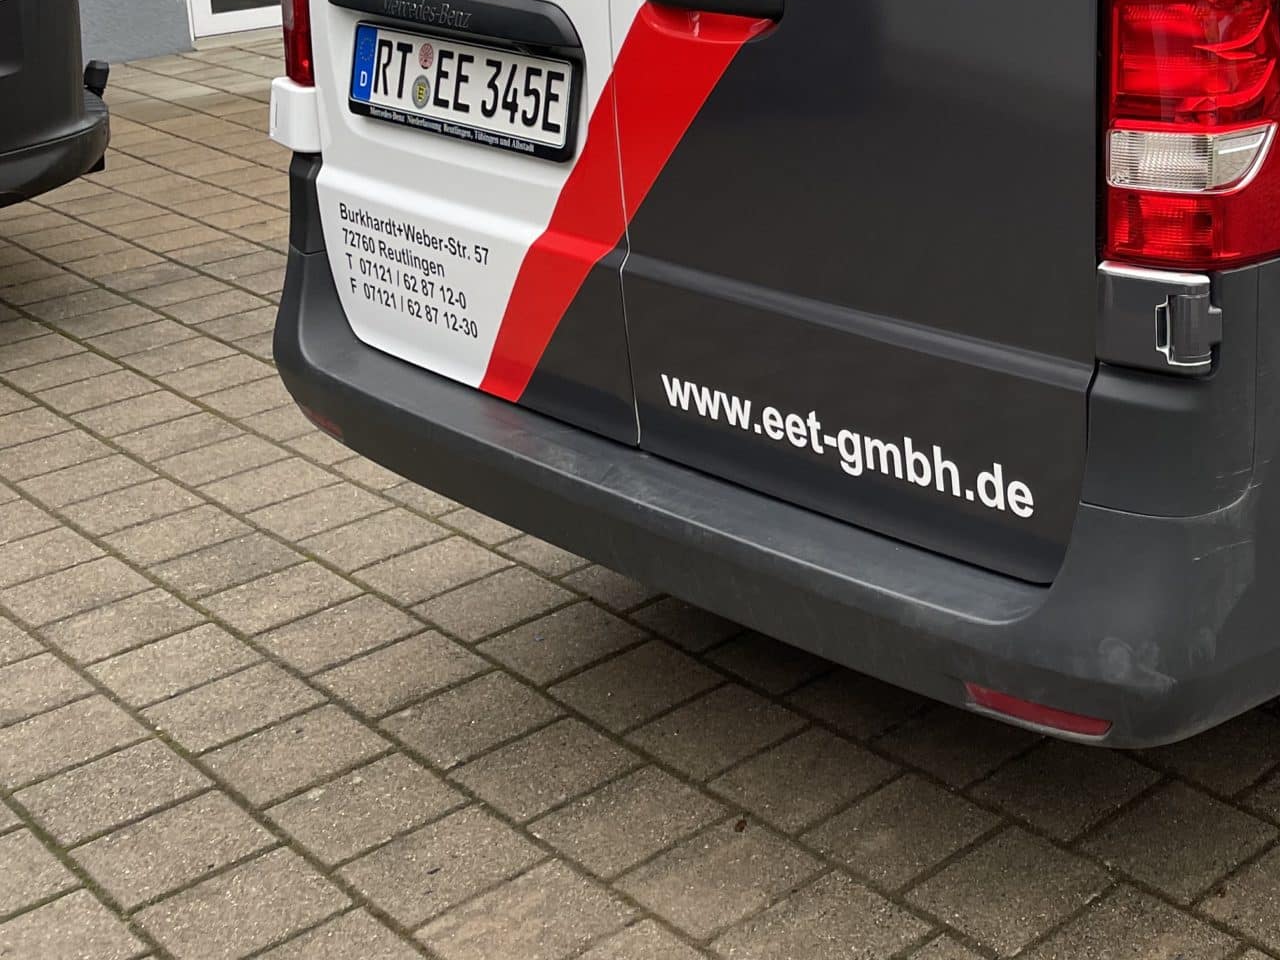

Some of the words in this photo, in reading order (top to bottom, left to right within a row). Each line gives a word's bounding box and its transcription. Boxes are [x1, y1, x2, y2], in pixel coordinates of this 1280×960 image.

[359, 71, 368, 87] D
[373, 39, 413, 99] RT
[433, 49, 475, 113] EE
[481, 58, 565, 134] 345E
[339, 202, 471, 261] Burkhardt+Weber-Str.
[474, 245, 489, 266] 57
[342, 227, 376, 254] 72760
[378, 239, 445, 278] Reutlingen
[345, 252, 353, 270] T
[360, 257, 393, 284] 07121
[403, 273, 418, 293] 62
[421, 278, 435, 298] 87
[440, 285, 467, 310] 12-0
[350, 277, 357, 294] F
[363, 282, 397, 310] 07121
[407, 298, 422, 319] 62
[425, 304, 438, 324] 87
[443, 311, 478, 339] 12-30
[660, 373, 1035, 519] www.eet-gmbh.de
